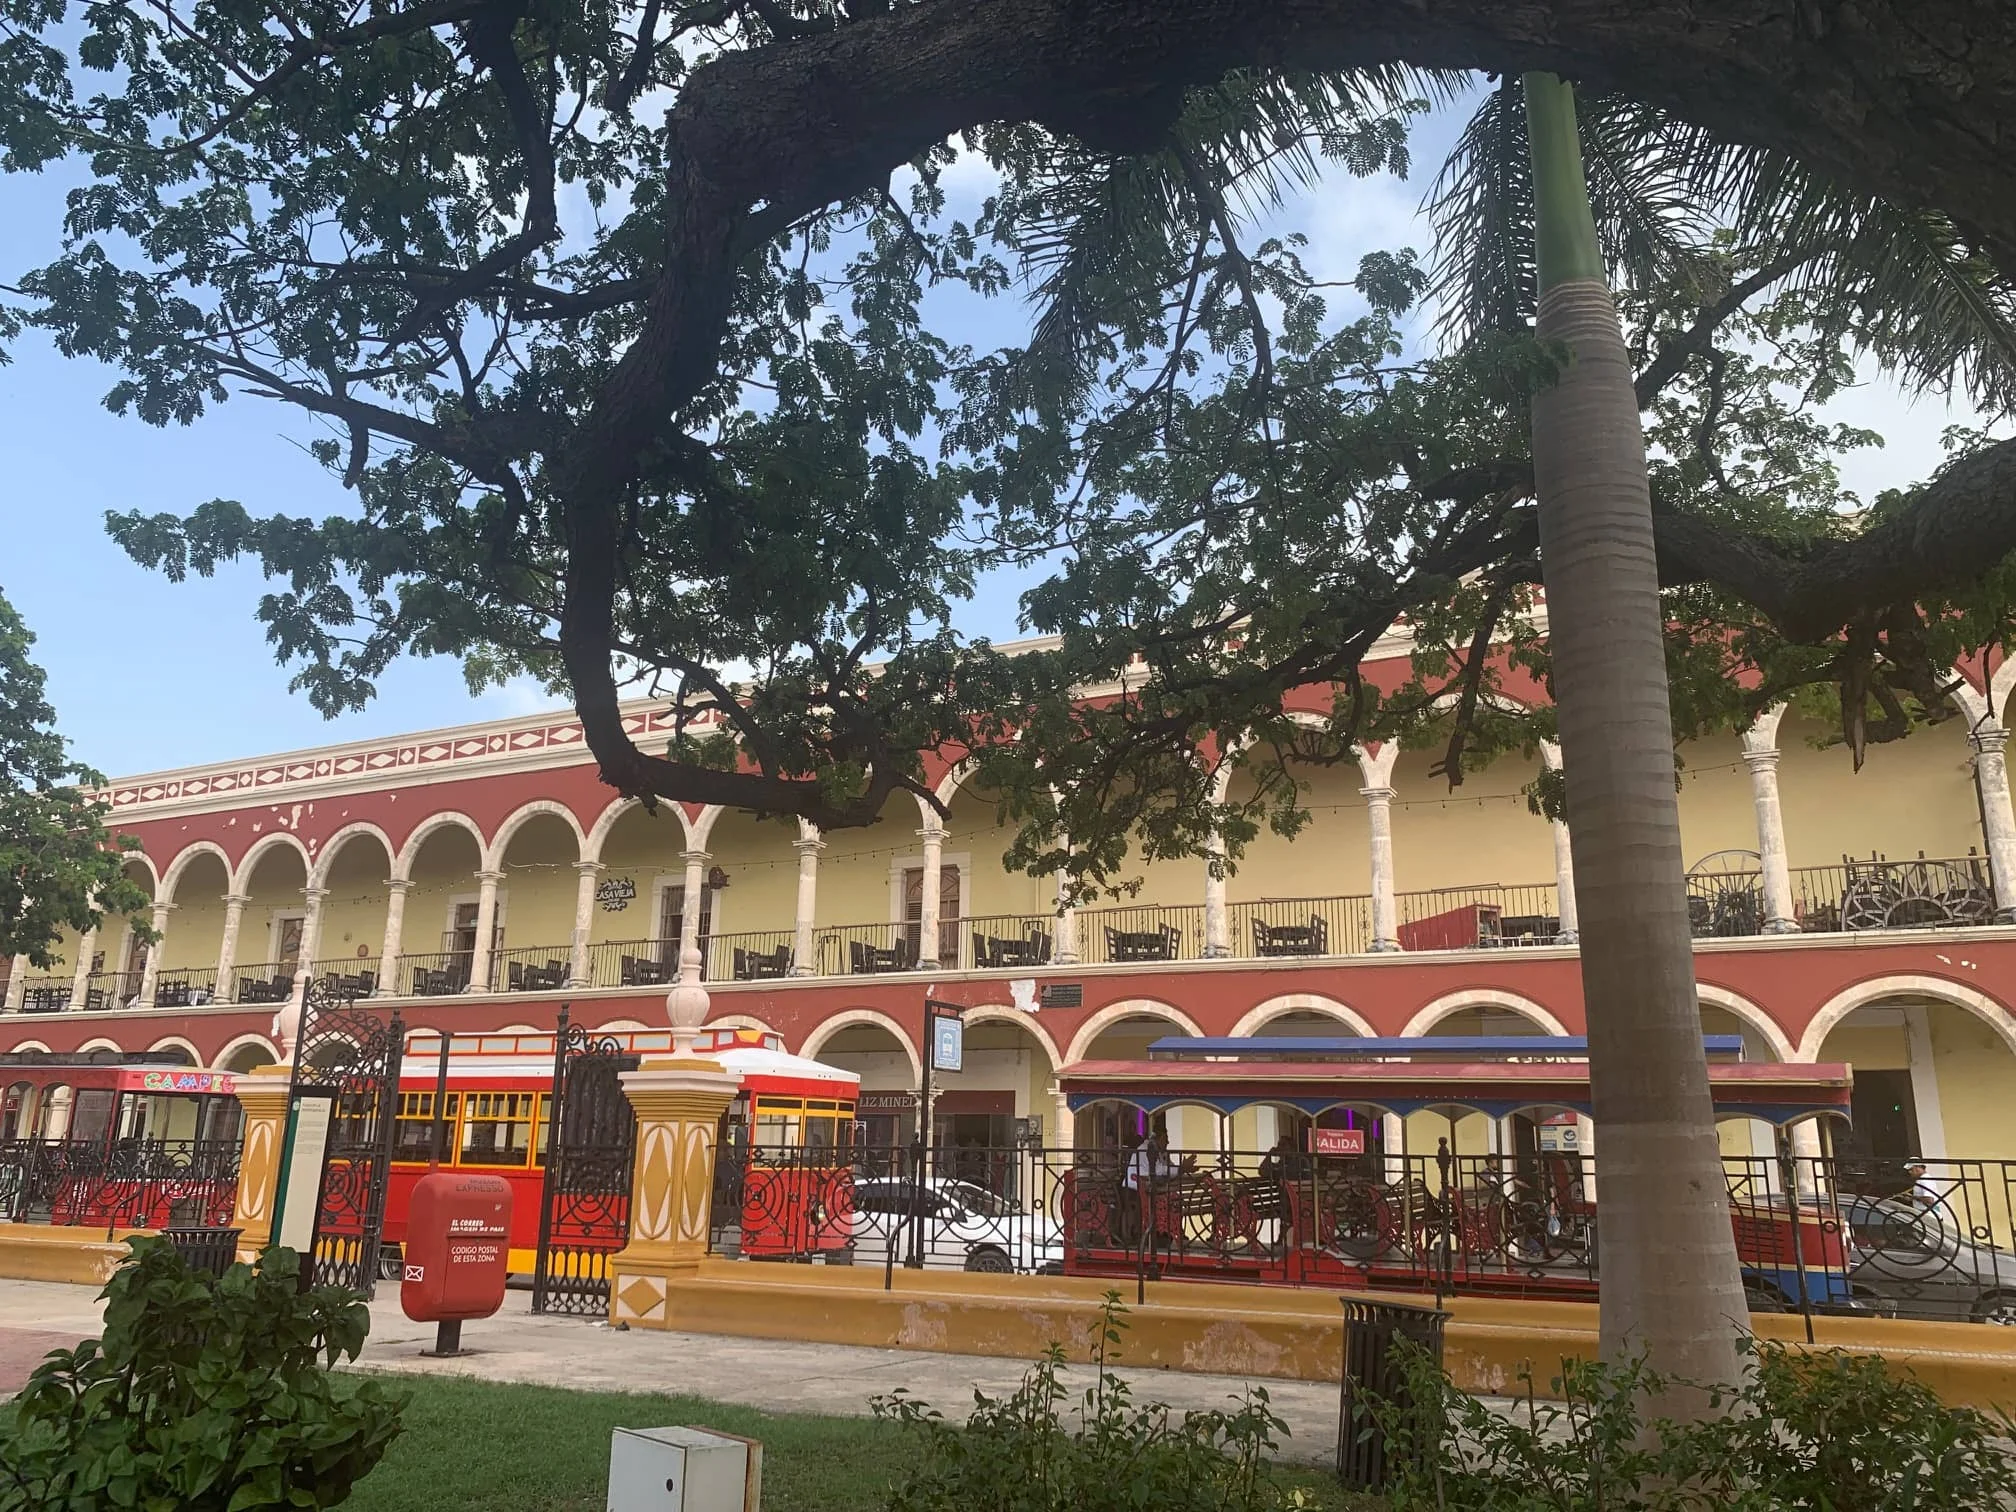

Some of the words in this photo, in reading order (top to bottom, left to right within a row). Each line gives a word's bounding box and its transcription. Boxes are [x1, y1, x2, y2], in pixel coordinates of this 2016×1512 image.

[614, 888, 634, 898] VIEJA
[859, 1096, 878, 1107] LIZ
[451, 1246, 477, 1254] CODIGO
[478, 1245, 499, 1254] POSTAL
[453, 1254, 461, 1263] DE
[463, 1254, 476, 1263] ESTA
[478, 1254, 495, 1262] ZONA
